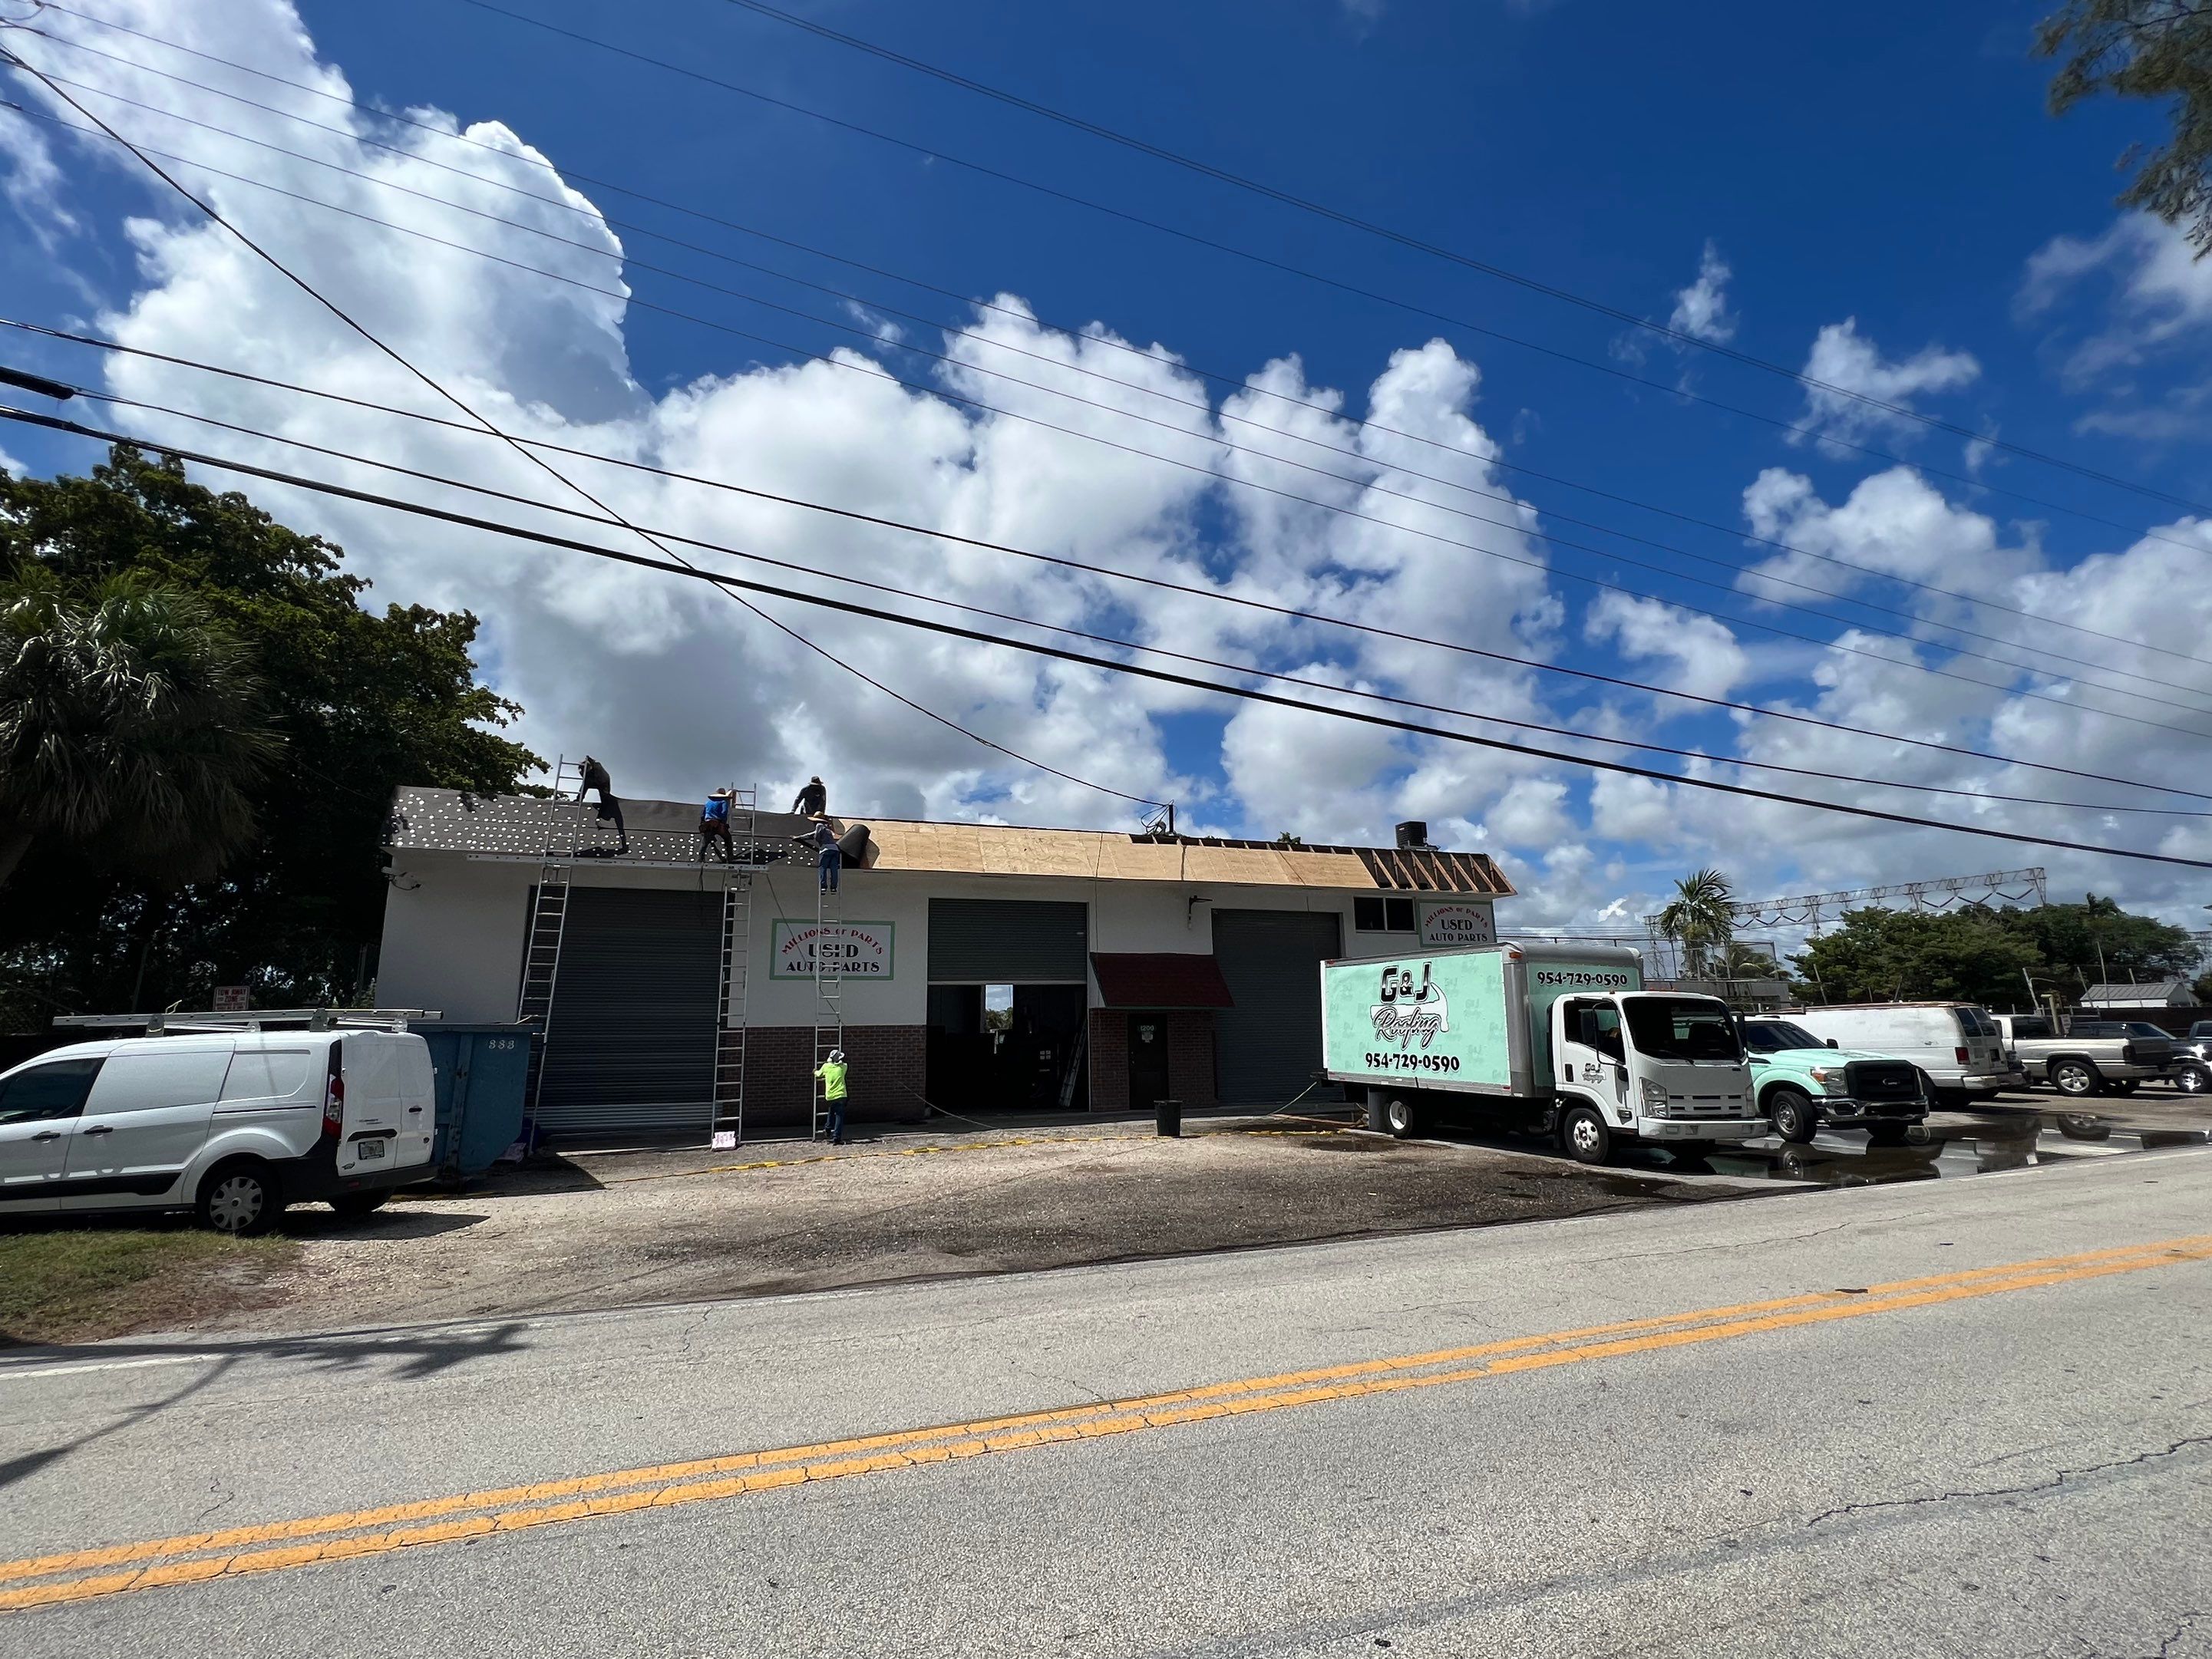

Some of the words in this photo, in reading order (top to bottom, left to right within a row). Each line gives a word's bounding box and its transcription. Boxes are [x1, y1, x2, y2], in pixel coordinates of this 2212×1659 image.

[1425, 906, 1454, 927] MILLIONS
[1465, 908, 1488, 928] PARTS
[1441, 919, 1473, 930] USED
[781, 927, 830, 955] MILLIONS
[851, 929, 883, 955] PARTS
[1429, 932, 1454, 942] AUTO
[1458, 932, 1488, 942] PARTS
[808, 943, 859, 958] USED
[832, 961, 880, 972] PARTS
[1380, 961, 1431, 1004] G&J
[1537, 971, 1628, 987] 954-729-0590
[1372, 1006, 1441, 1050] Roofing
[1365, 1051, 1461, 1073] 954-729-0590
